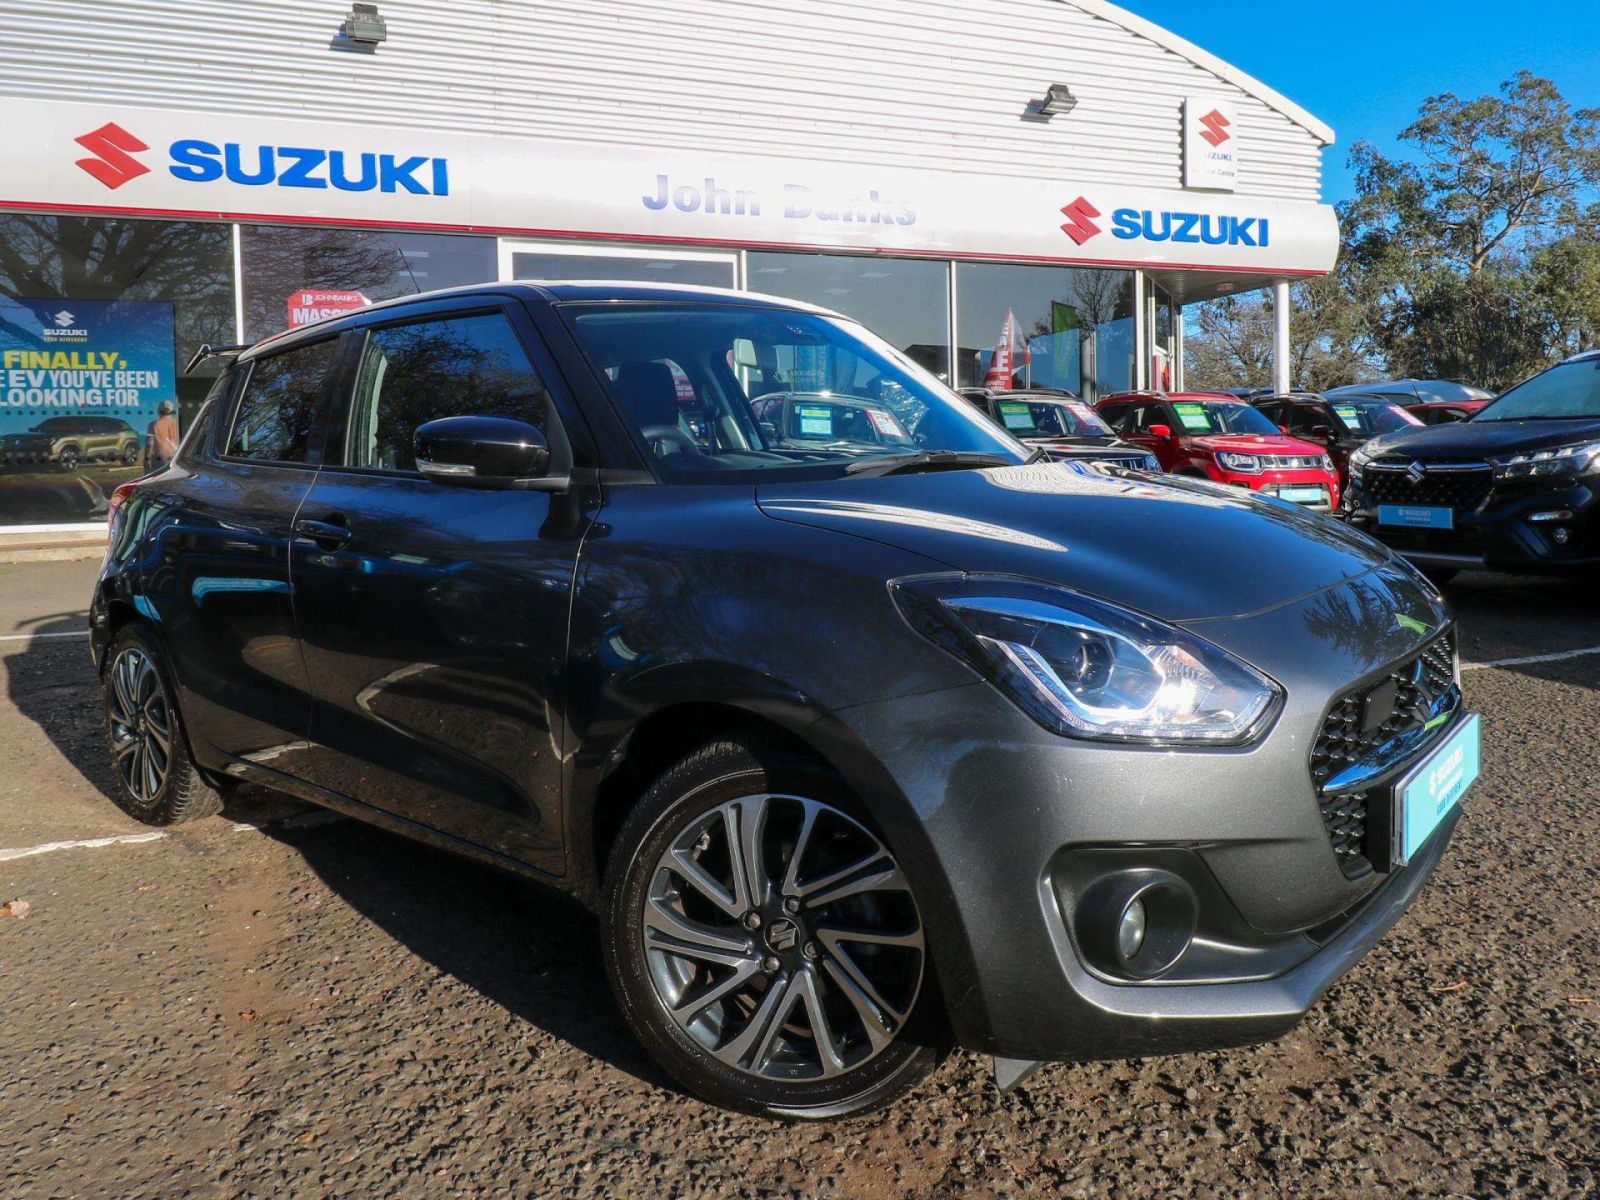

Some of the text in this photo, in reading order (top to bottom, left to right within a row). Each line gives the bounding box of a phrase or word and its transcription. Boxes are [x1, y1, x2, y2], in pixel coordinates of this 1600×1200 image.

[169, 139, 448, 197] SUZUKI
[642, 174, 916, 226] John Banks
[1111, 208, 1269, 247] SUZUKI
[43, 328, 88, 336] SUZUKI
[4, 351, 128, 370] FINALLY,
[9, 370, 48, 388] EV
[50, 370, 113, 388] YOU'VE
[115, 371, 159, 388] BEEN
[106, 389, 140, 407] FOR
